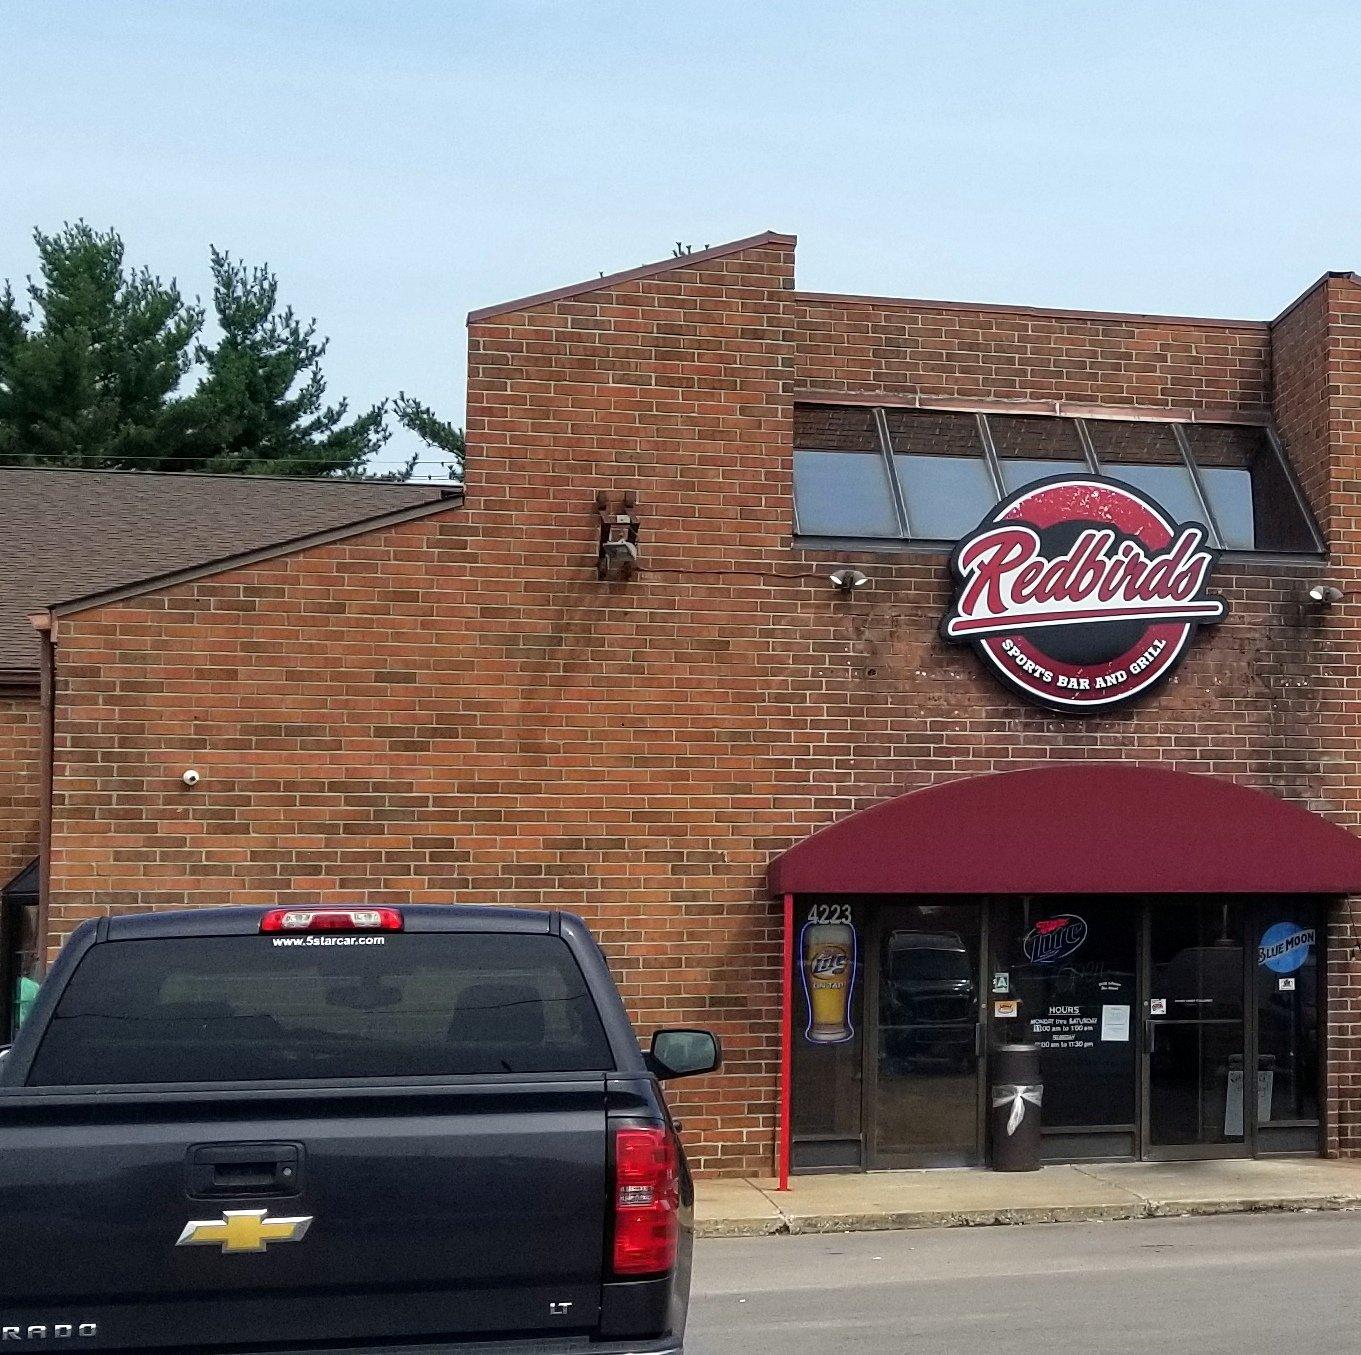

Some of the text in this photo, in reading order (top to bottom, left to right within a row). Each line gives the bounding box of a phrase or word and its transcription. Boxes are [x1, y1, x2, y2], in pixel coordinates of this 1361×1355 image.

[959, 527, 1212, 618] Redbirds
[1002, 638, 1167, 690] SPORTS BAR AND GRILL
[807, 904, 852, 924] 4223
[272, 936, 385, 946] www.5starcar.com
[1285, 931, 1315, 952] MOON
[1049, 1006, 1080, 1014] HOURS
[549, 1302, 573, 1316] LT
[2, 1323, 98, 1341] RADO
